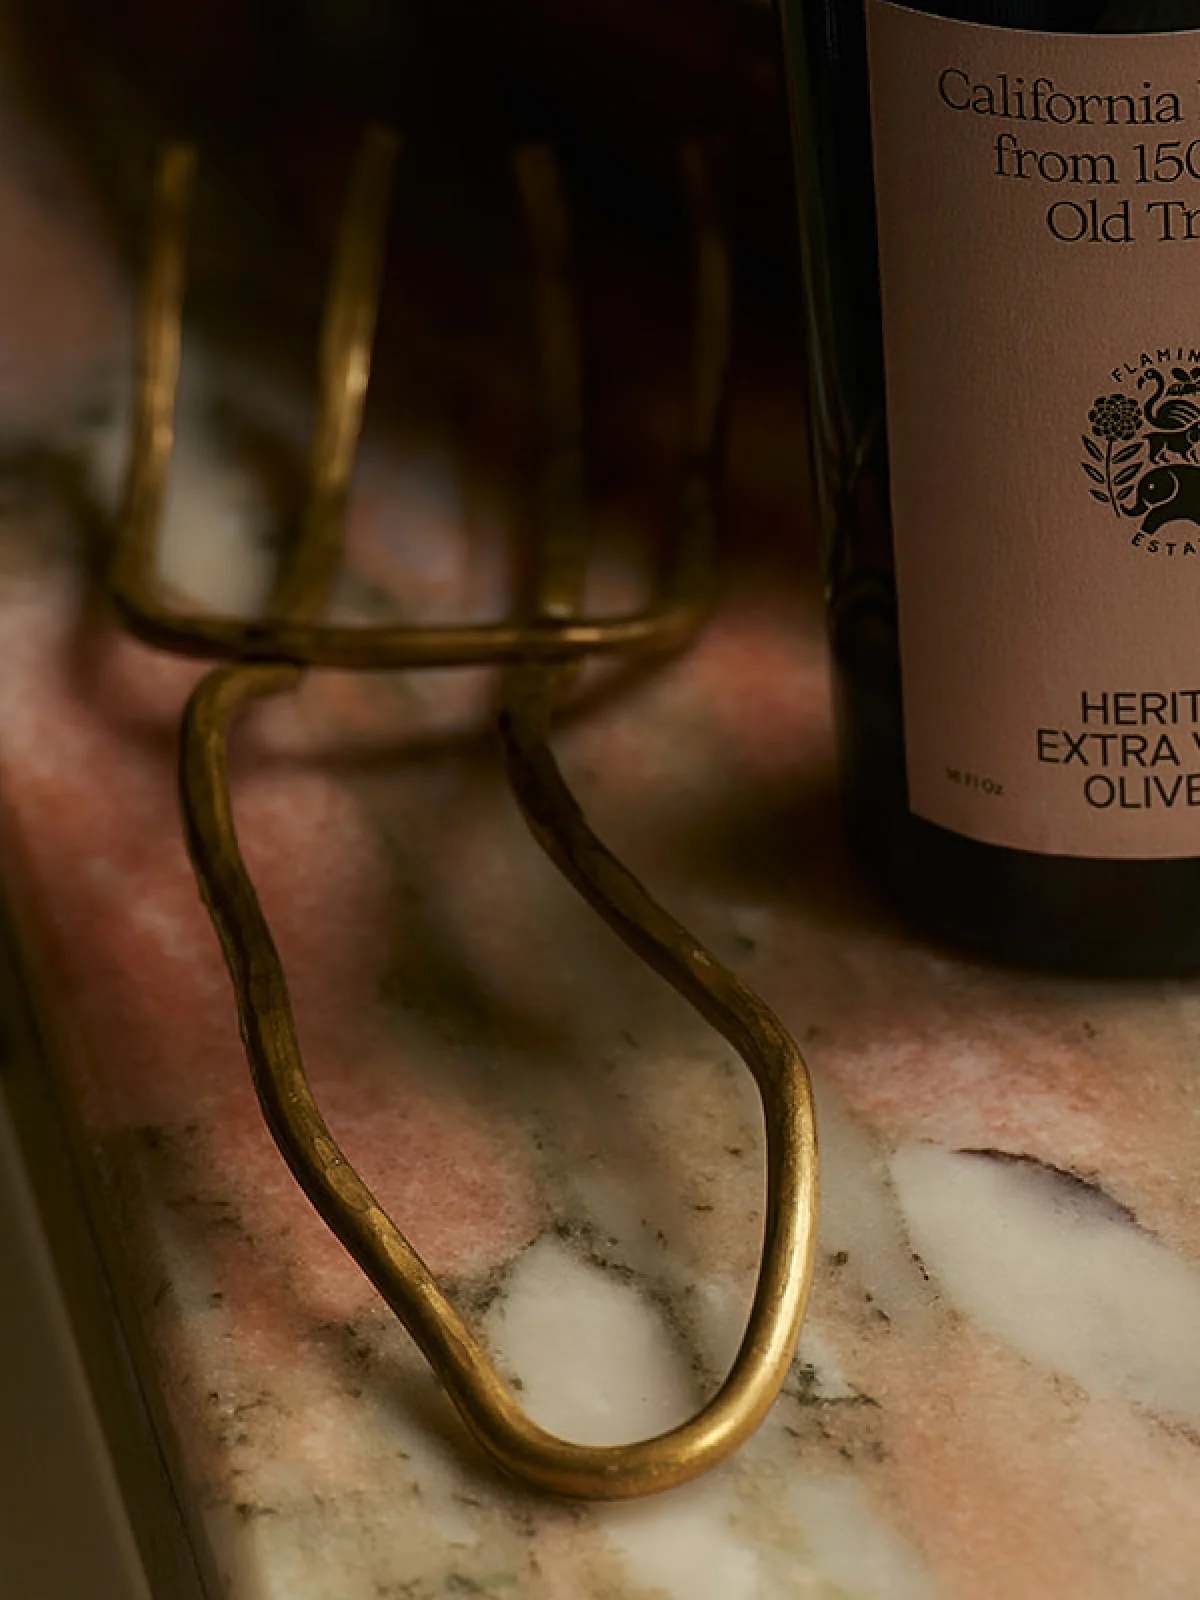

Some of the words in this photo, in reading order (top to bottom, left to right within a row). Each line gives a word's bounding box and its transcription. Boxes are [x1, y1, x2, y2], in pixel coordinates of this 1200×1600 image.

[938, 68, 1184, 125] California
[994, 134, 1119, 184] from
[1046, 199, 1133, 243] Old
[1037, 729, 1181, 767] EXTRA
